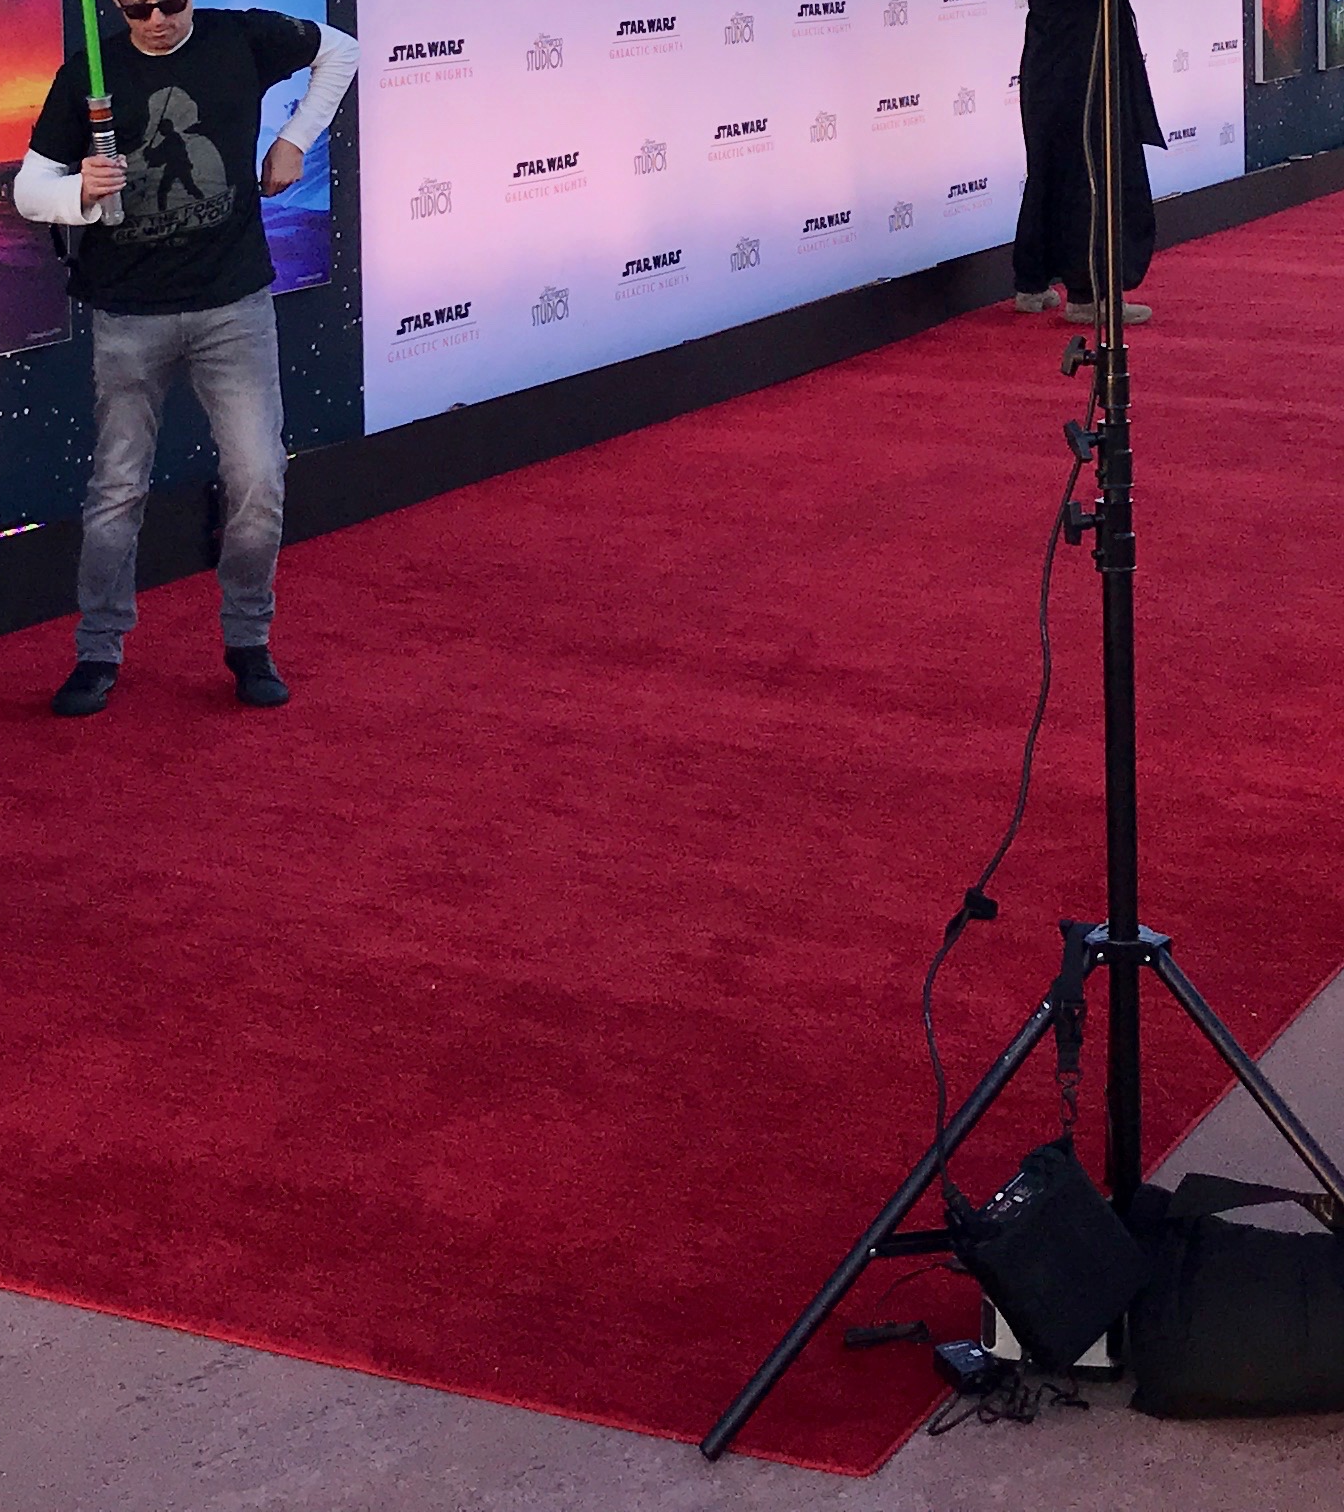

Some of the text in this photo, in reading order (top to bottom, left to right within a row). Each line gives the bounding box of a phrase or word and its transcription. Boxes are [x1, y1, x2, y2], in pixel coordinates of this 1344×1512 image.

[798, 1, 845, 17] STAR WARS
[617, 17, 676, 36] STAR WARS
[389, 39, 464, 62] STAR WARS
[526, 46, 563, 72] STUDIOS
[609, 45, 650, 60] GALACTIC
[379, 66, 473, 89] GALACTIC NIGHTS
[715, 119, 767, 139] STAR WARS
[513, 152, 579, 178] STAR WARS
[633, 151, 667, 175] STUDIOS
[410, 191, 452, 221] STUDIOS
[505, 185, 550, 204] GALACTIC
[803, 211, 851, 233] STAR WARS
[623, 250, 681, 277] STAR WARS
[397, 302, 471, 335] STAR WARS
[531, 297, 570, 327] STUDIOS
[387, 337, 438, 363] GALACTIC
